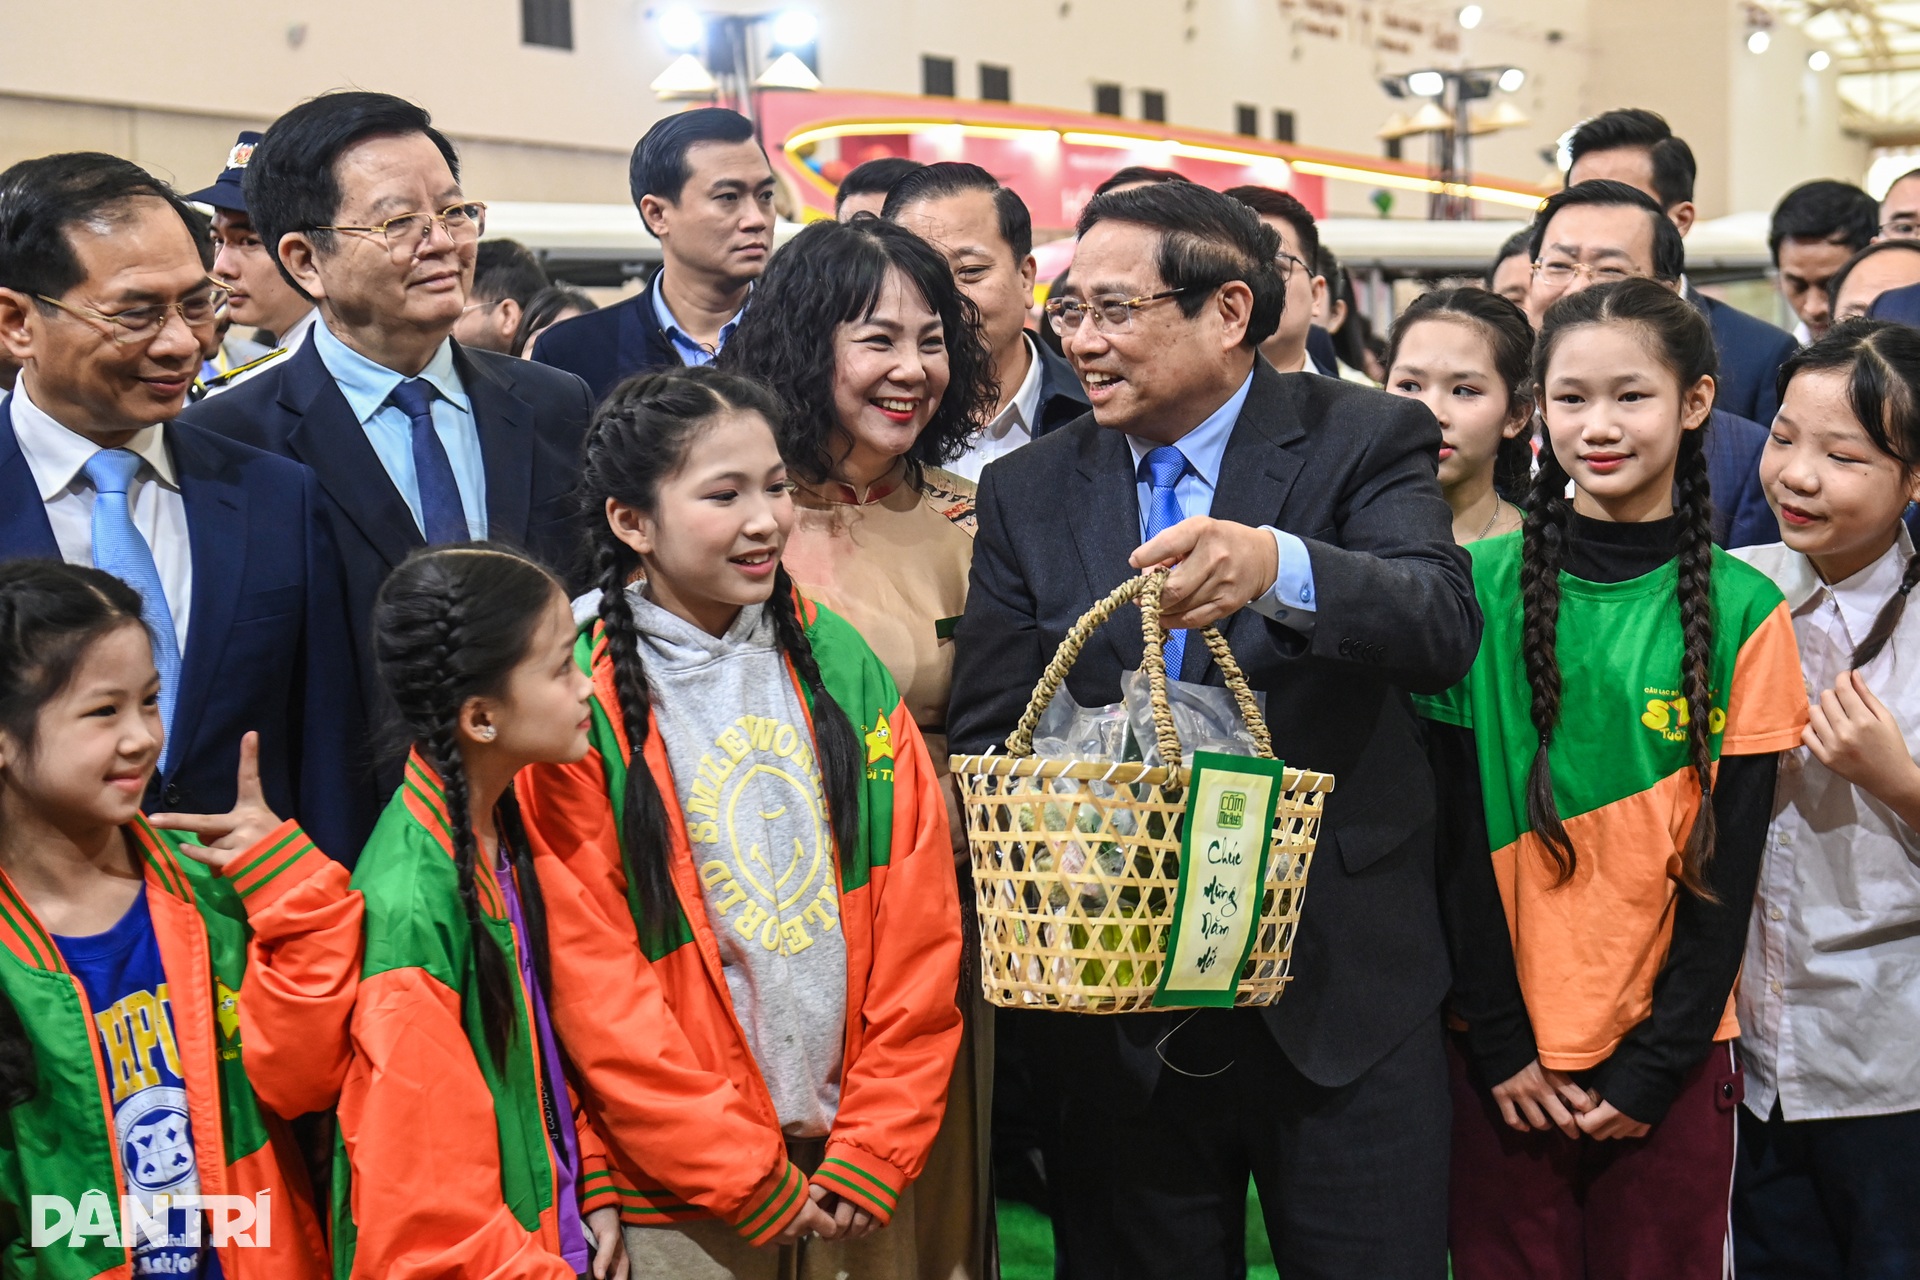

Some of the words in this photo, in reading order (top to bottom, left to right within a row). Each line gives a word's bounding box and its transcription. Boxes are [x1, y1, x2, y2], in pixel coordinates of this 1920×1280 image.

[686, 725, 753, 844] SMILE
[1207, 836, 1243, 865] Chúc
[1202, 875, 1238, 917] Mừng
[1201, 911, 1229, 940] Năm
[1194, 946, 1218, 974] Mới
